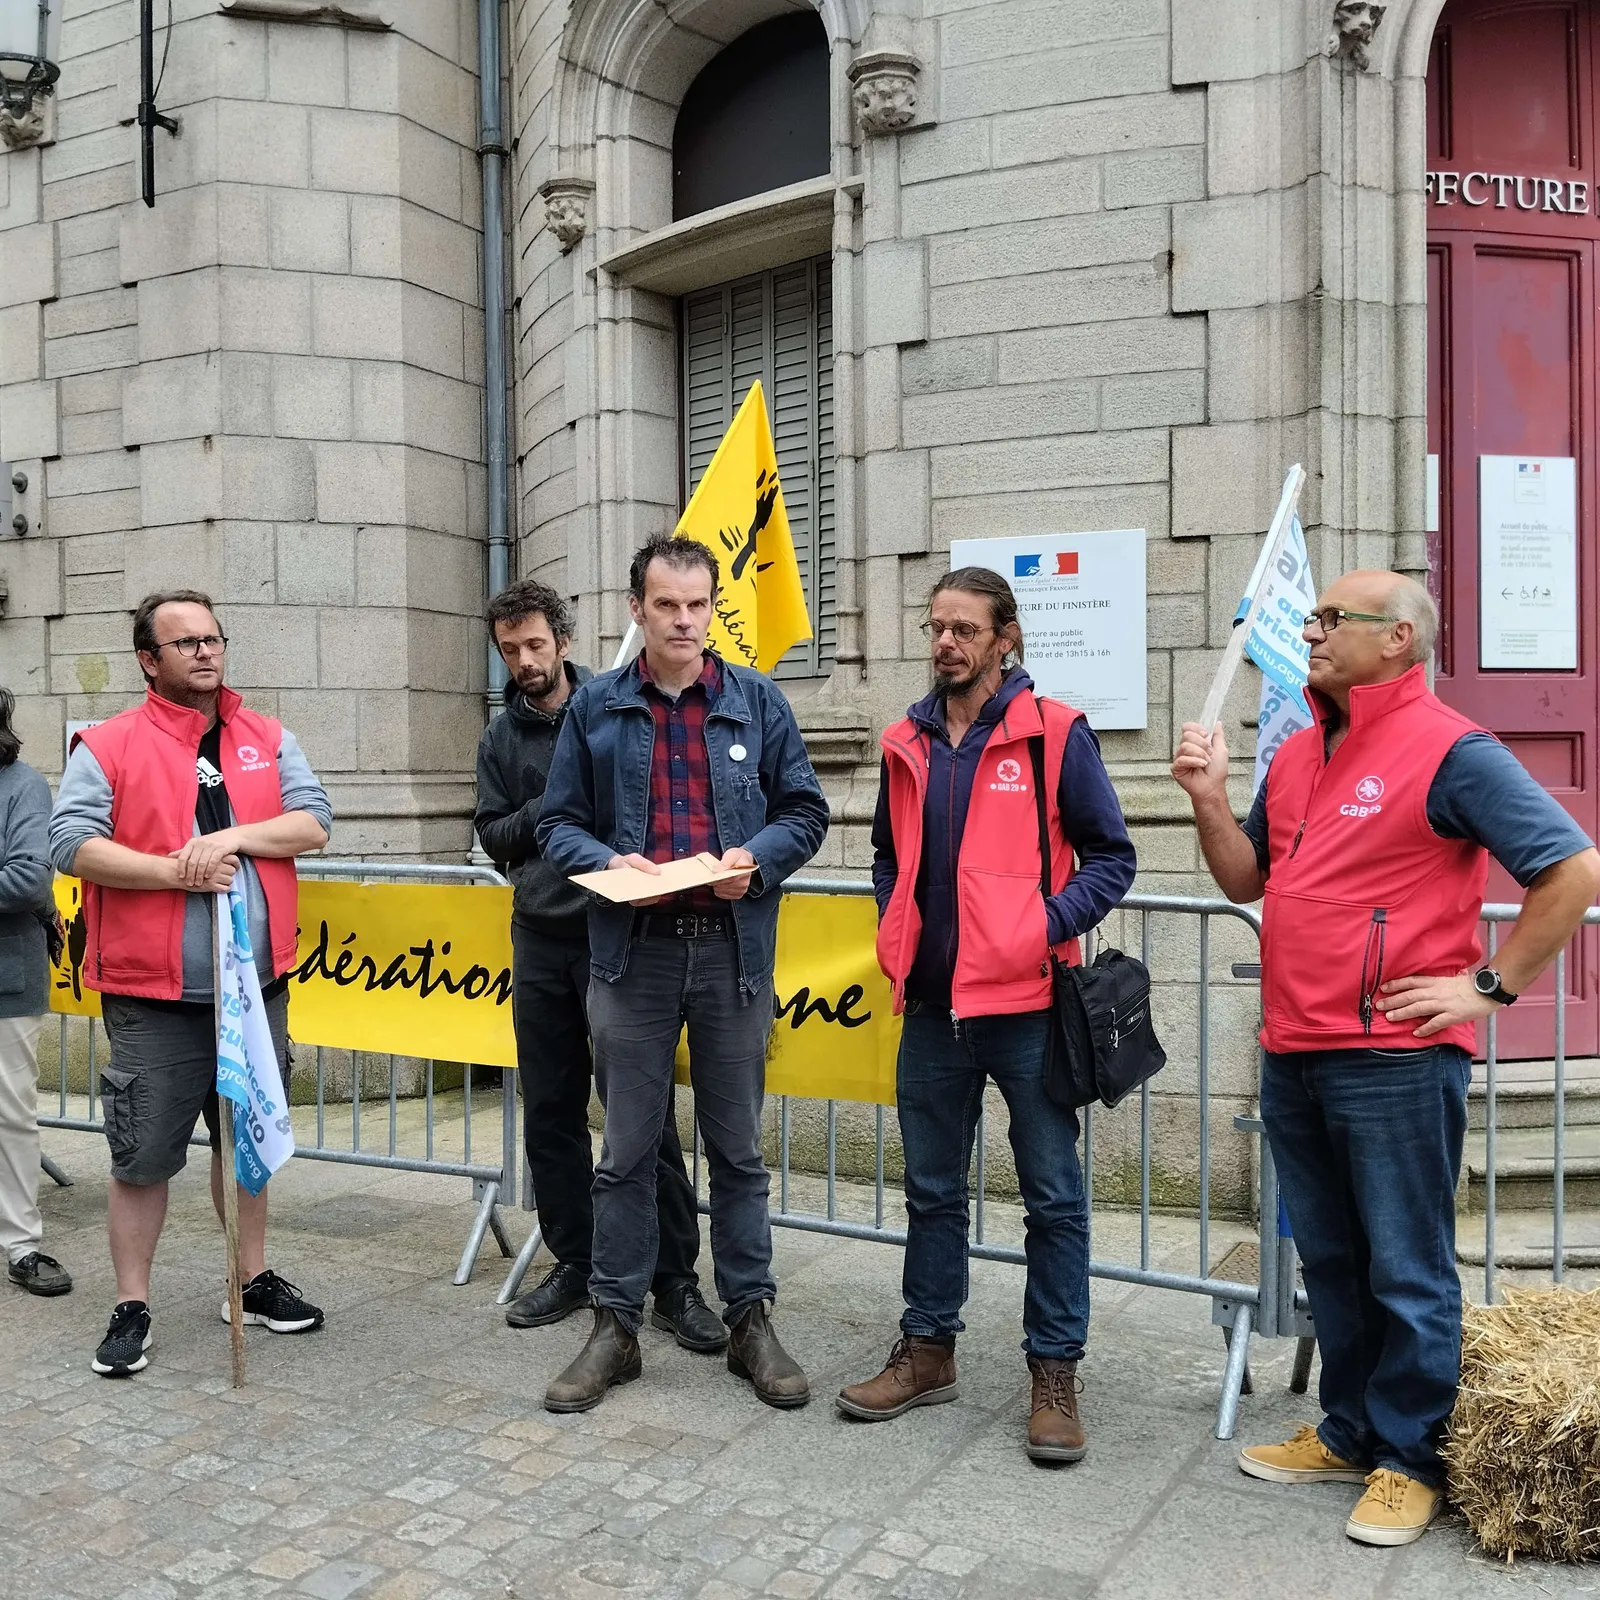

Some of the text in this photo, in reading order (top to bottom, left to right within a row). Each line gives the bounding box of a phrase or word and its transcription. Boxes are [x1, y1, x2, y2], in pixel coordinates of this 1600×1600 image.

[1017, 598, 1111, 611] TURE DU FINISTÈRE
[715, 586, 757, 670] édéra
[1060, 629, 1083, 638] public
[1066, 650, 1088, 658] 13h15
[1097, 649, 1111, 657] 16h
[287, 919, 513, 1006] dération
